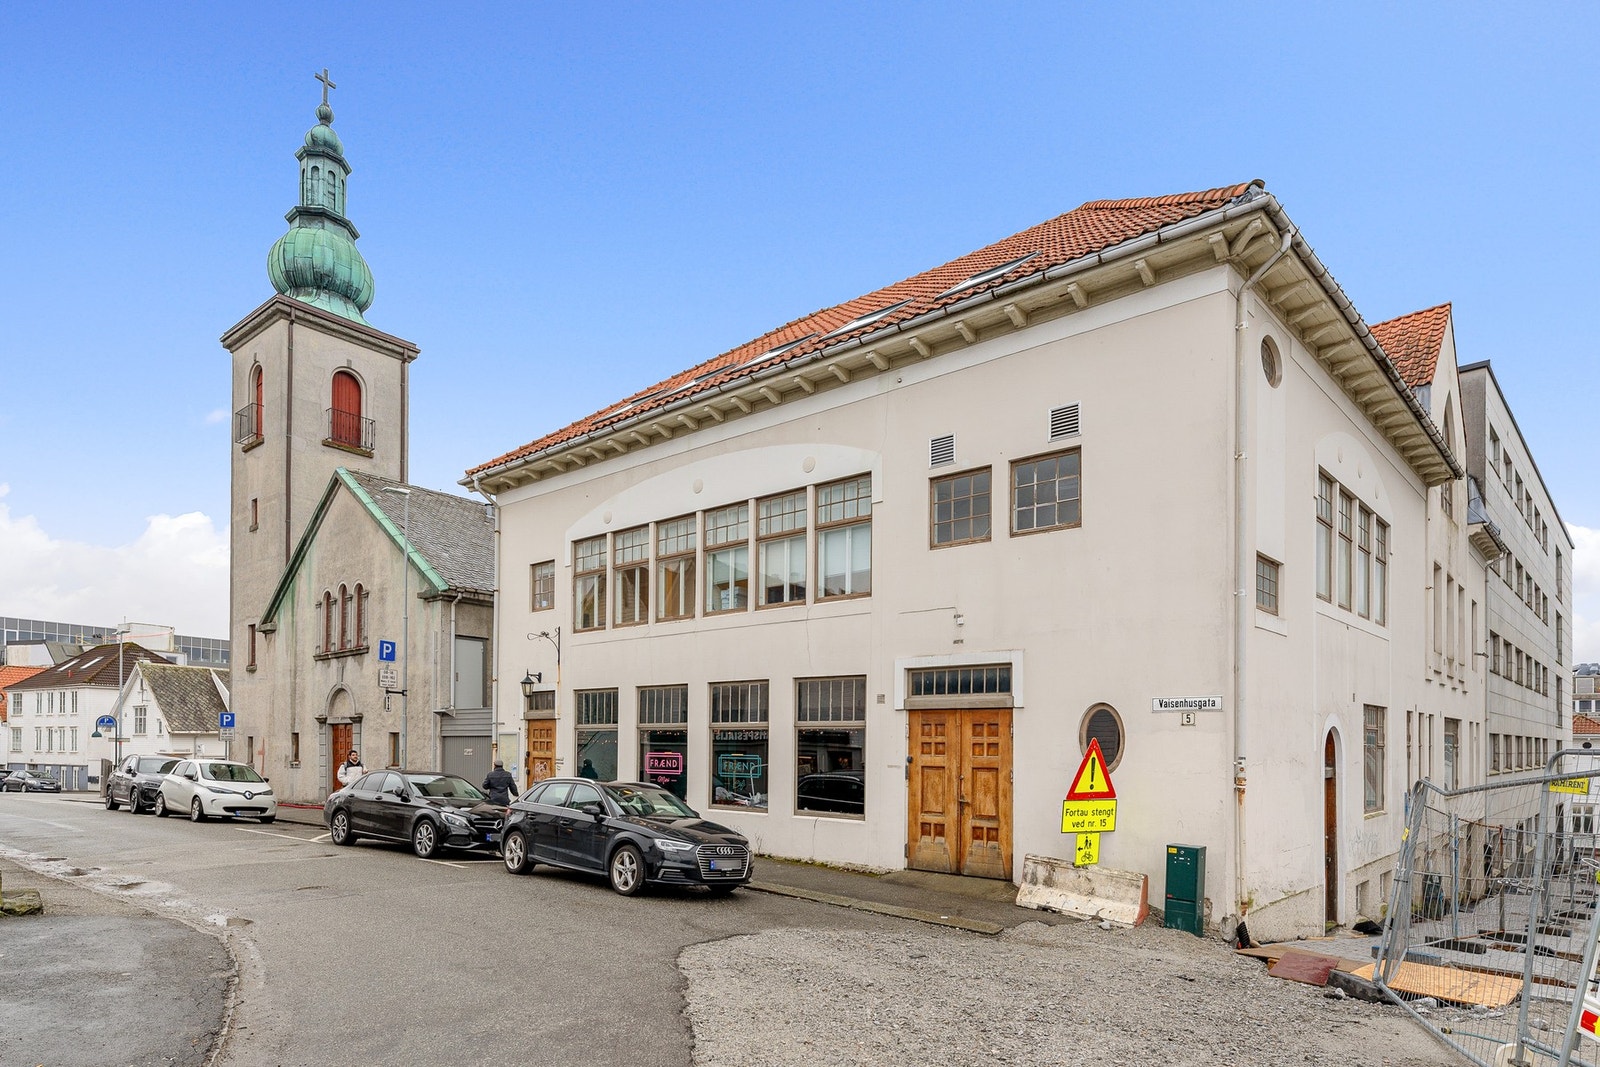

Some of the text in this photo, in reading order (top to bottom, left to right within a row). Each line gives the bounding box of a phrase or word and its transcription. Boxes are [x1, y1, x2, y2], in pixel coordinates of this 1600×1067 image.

[383, 643, 392, 658] P
[1158, 698, 1216, 710] Vaisenhusgata
[223, 714, 231, 726] P
[1186, 714, 1191, 724] 5
[650, 759, 678, 768] FRÆND
[722, 761, 756, 771] FRÆND
[1066, 808, 1114, 818] Fortau stengt
[1072, 820, 1085, 828] ved
